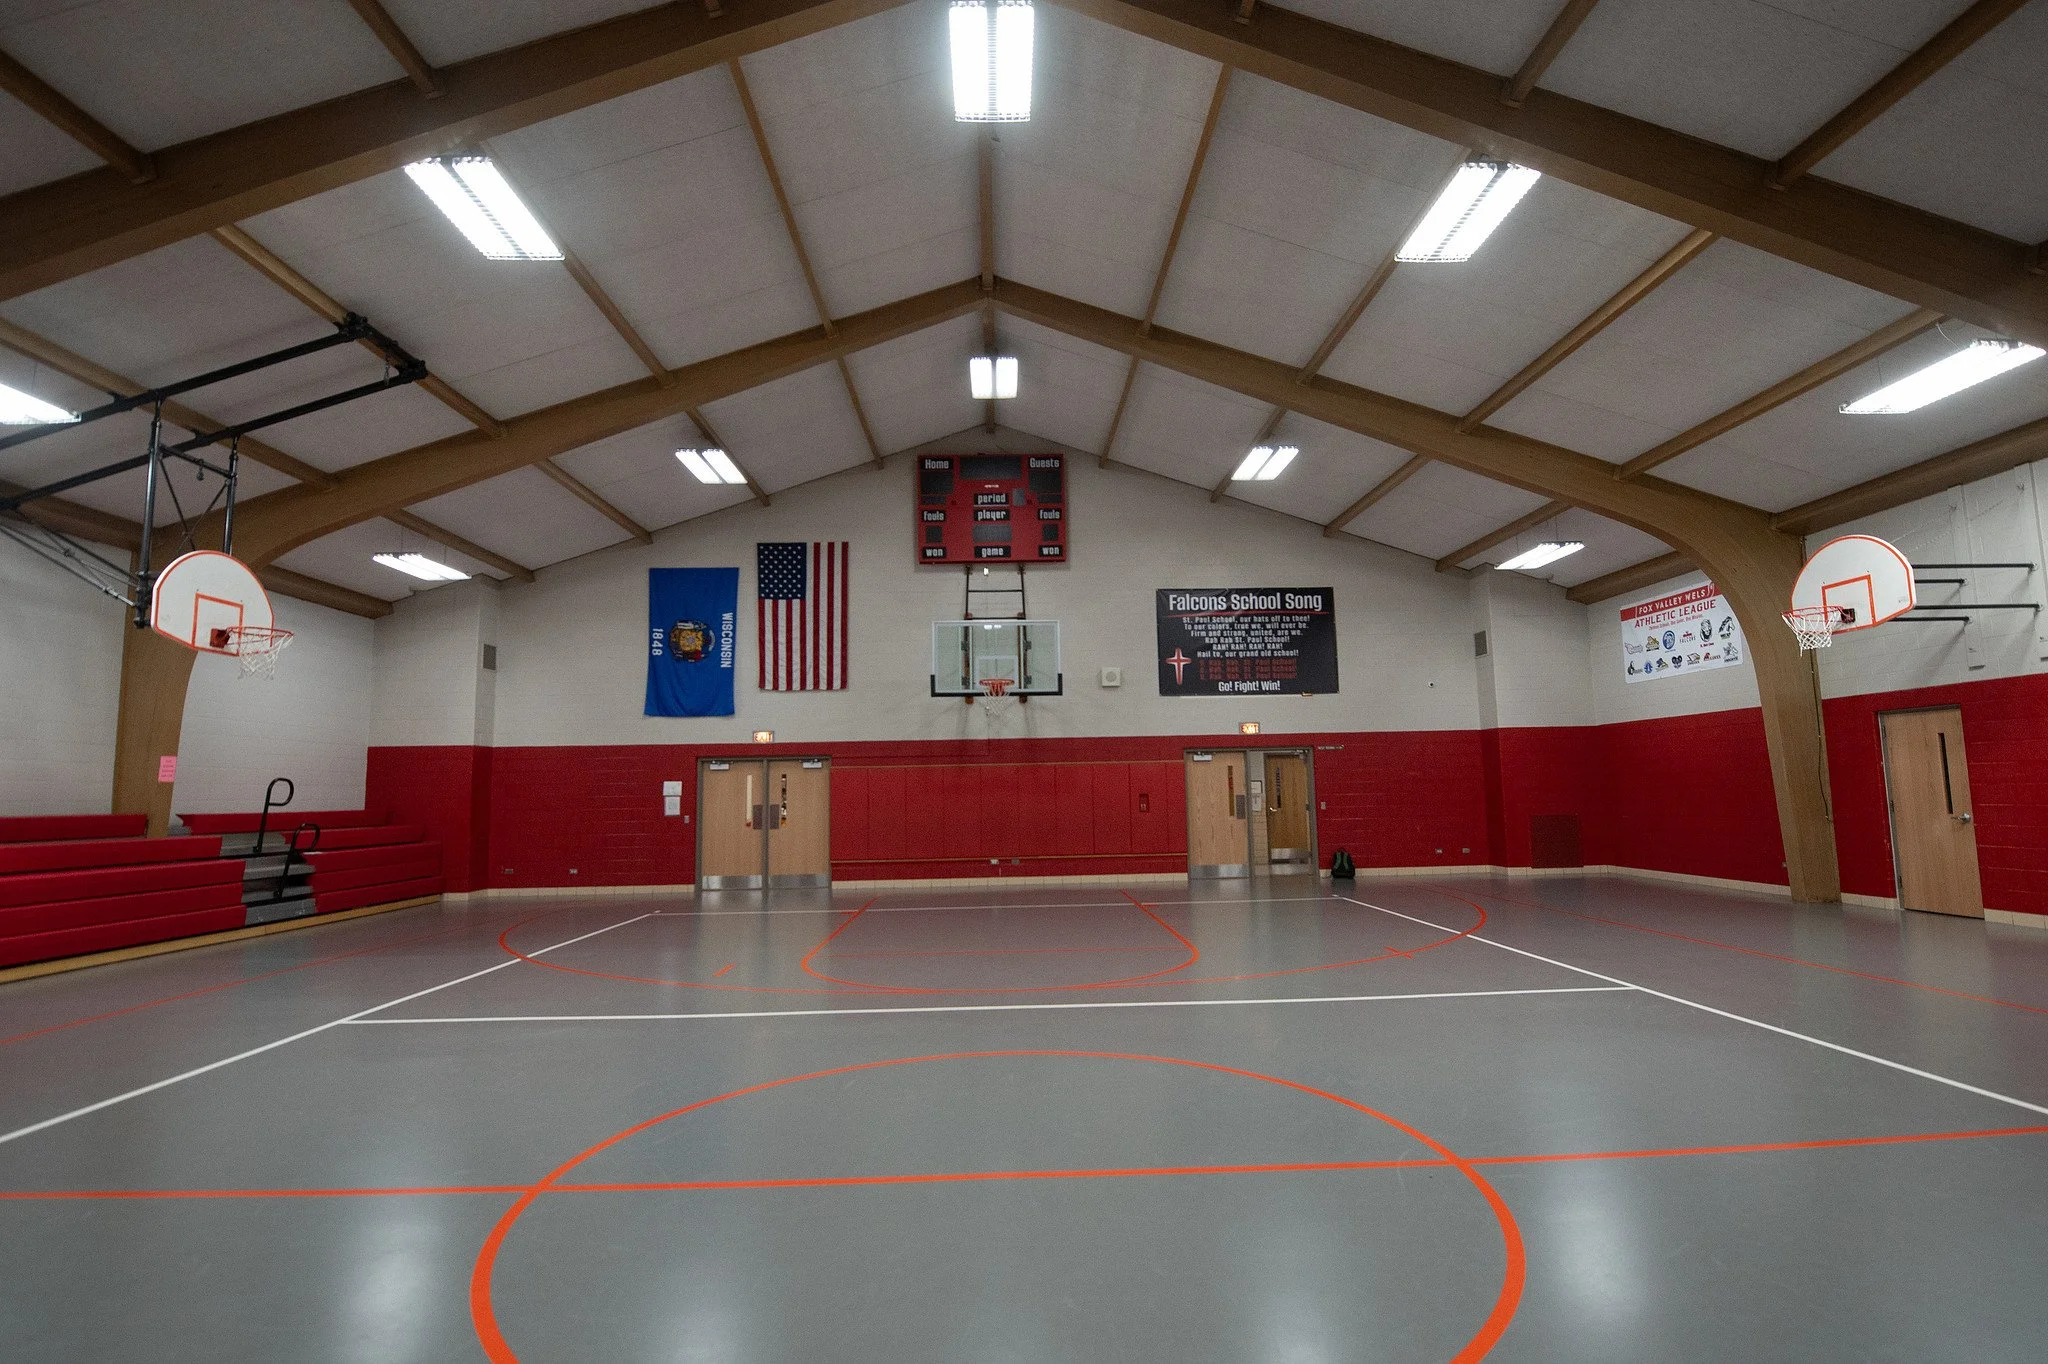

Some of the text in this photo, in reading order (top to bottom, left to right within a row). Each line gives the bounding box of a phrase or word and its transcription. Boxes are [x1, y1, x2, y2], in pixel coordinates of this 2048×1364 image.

[925, 459, 949, 470] Home
[1030, 458, 1060, 468] Guests
[978, 494, 1006, 504] period
[923, 511, 944, 521] fouls
[978, 510, 1006, 520] player
[1040, 509, 1060, 520] fouls
[926, 548, 944, 557] won
[982, 548, 1004, 558] game
[1042, 546, 1060, 556] won
[1169, 592, 1322, 612] Falcons School Song
[1639, 589, 1706, 614] FOX VALLEY WELS
[1635, 610, 1676, 628] ATHLETIC
[1679, 600, 1716, 616] LEAGUE
[652, 628, 664, 656] 1848
[720, 612, 734, 668] WISCONSIN
[1218, 680, 1280, 693] Go! Fight! Win!
[1240, 724, 1259, 734] EXIT
[754, 732, 772, 743] EXIT
